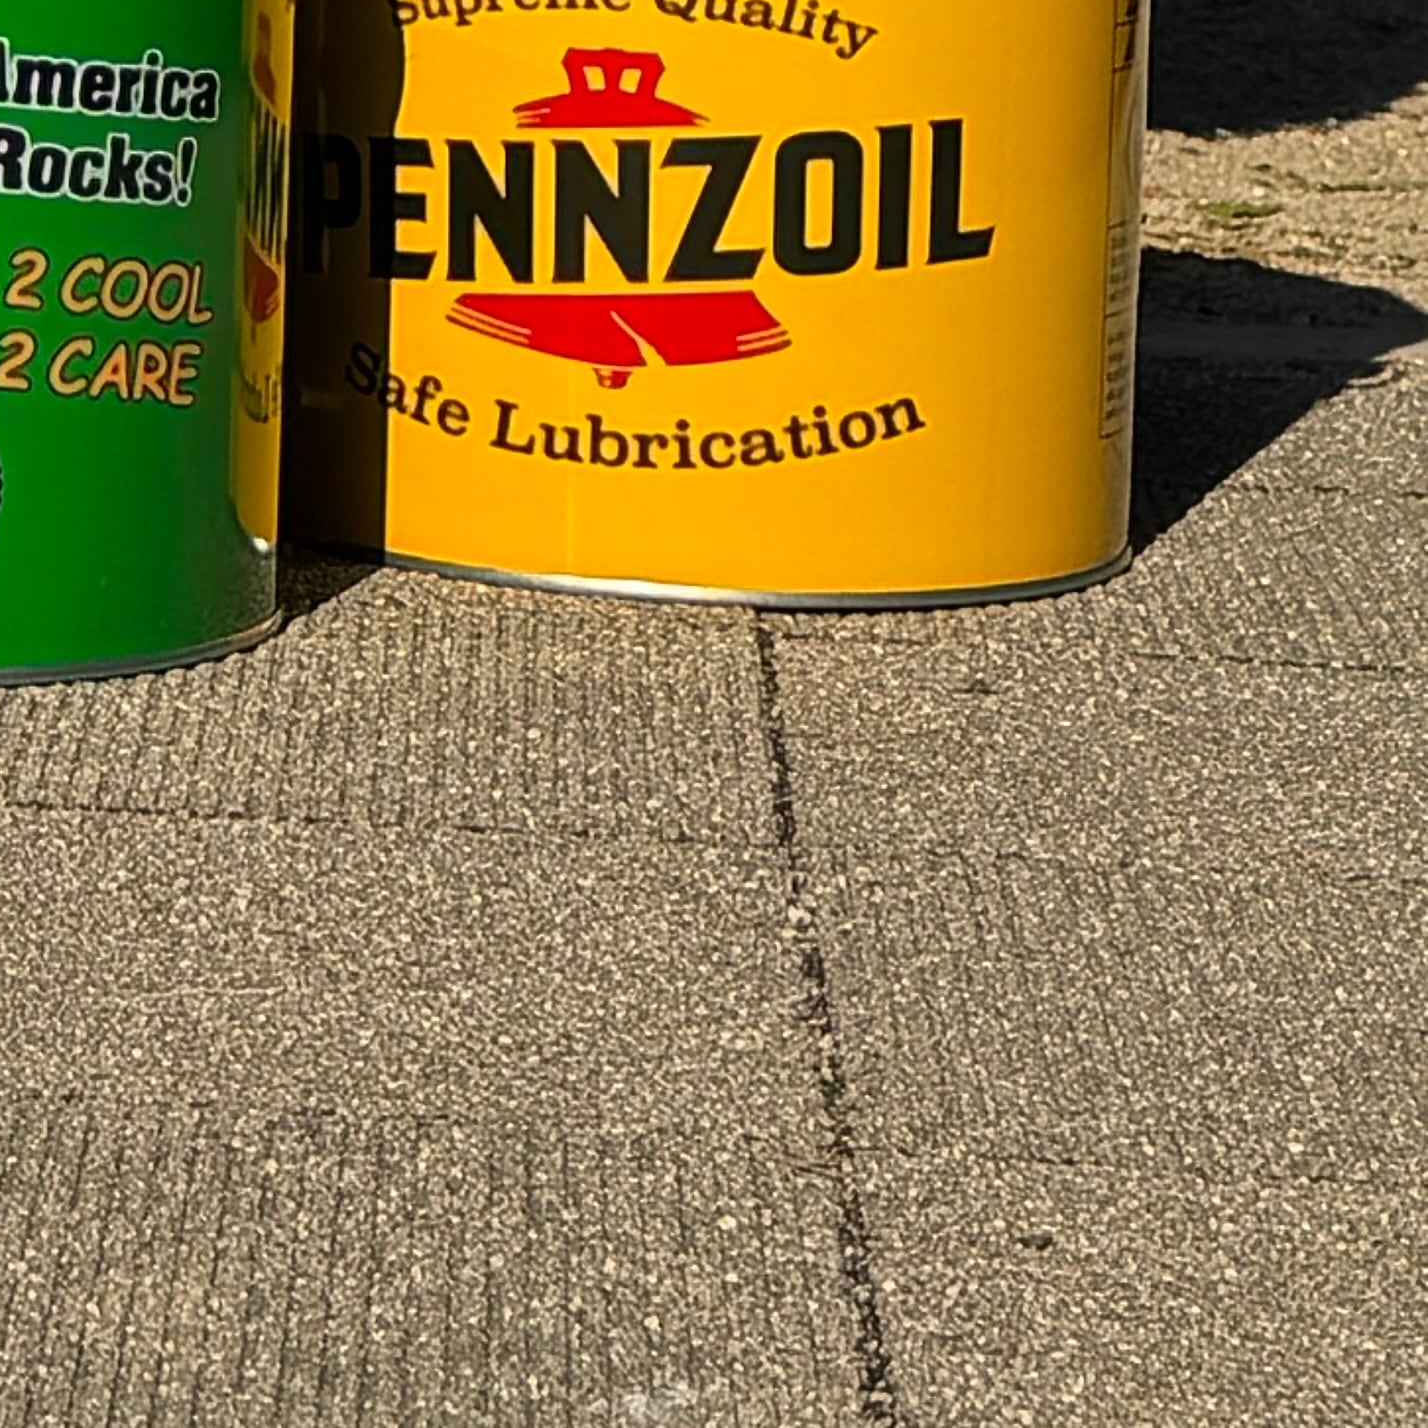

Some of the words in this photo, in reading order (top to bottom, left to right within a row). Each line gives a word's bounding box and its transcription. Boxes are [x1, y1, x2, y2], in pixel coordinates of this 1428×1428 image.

[300, 116, 997, 284] PENNZOIL
[4, 246, 50, 312] 2
[58, 253, 215, 325] COOL
[47, 335, 203, 407] CARE
[344, 342, 471, 438] Safe
[489, 393, 928, 471] Lubrication
